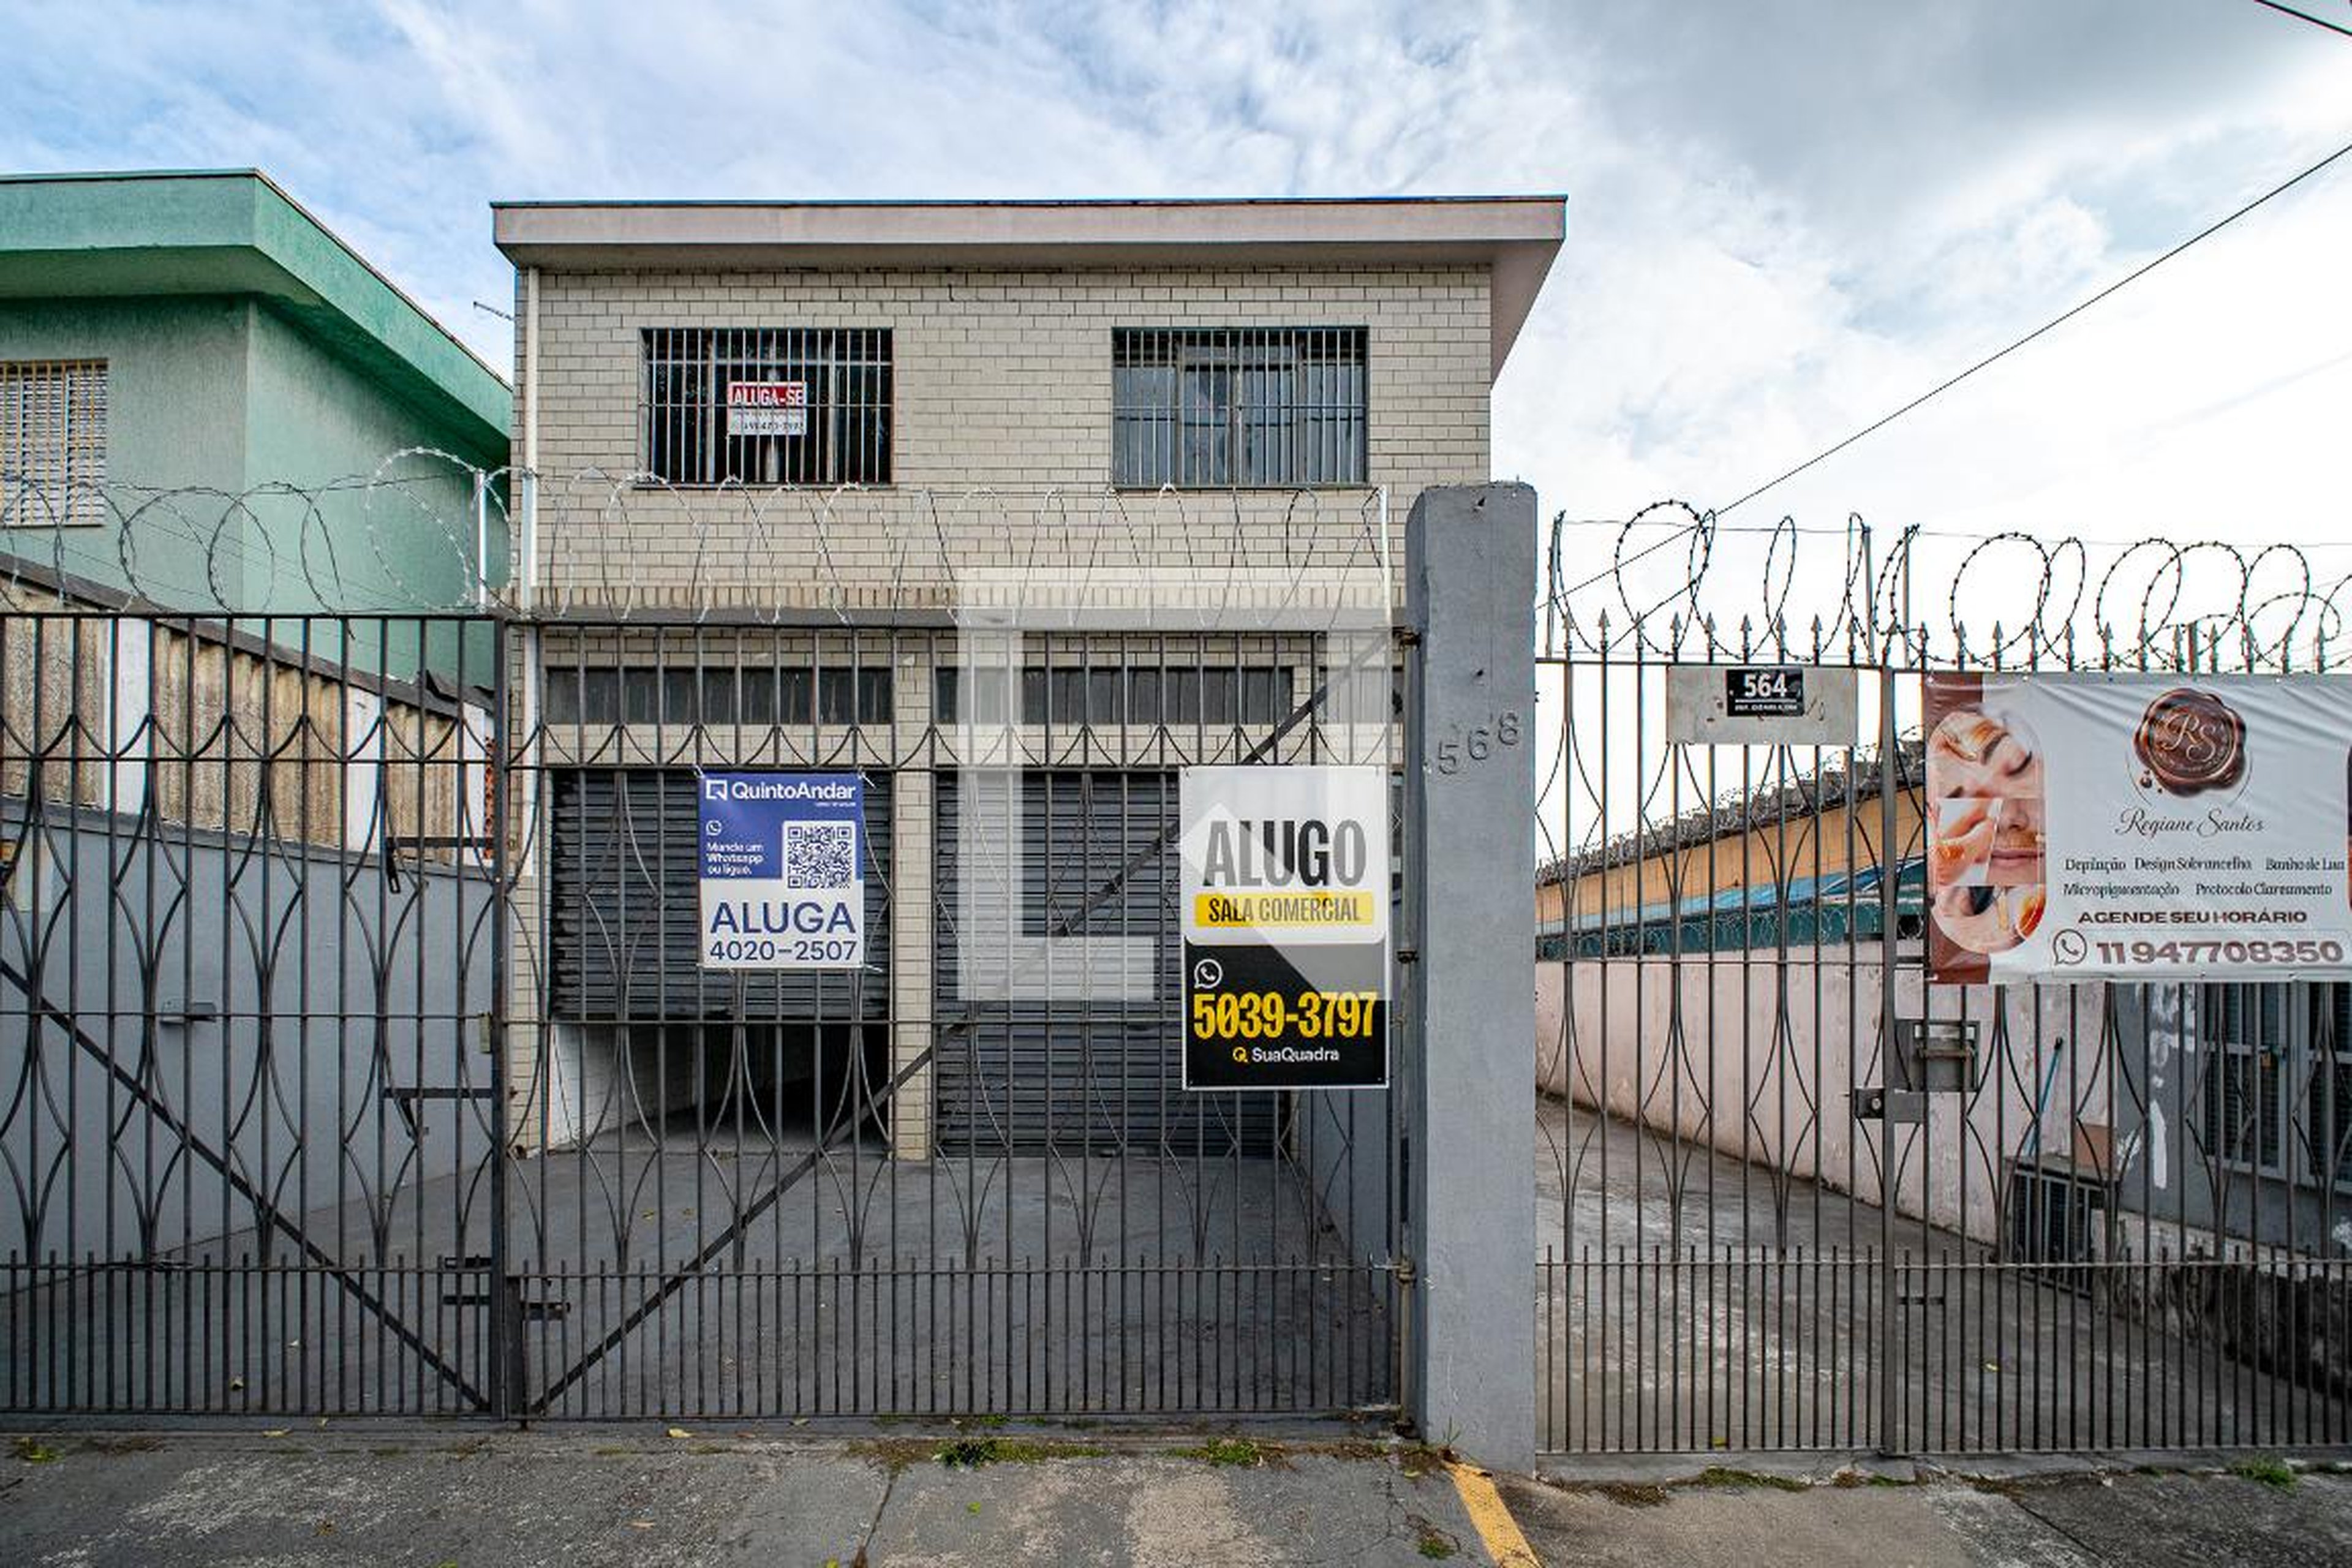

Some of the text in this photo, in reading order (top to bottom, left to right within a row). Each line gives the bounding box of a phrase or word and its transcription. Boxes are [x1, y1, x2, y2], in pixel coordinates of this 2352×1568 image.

[734, 387, 804, 406] ALUGA-SE
[1744, 673, 1788, 697] 564
[1438, 712, 1518, 775] 568
[731, 781, 856, 800] QuintoAndar
[2115, 807, 2266, 839] Regiane Santos
[1202, 820, 1367, 887] ALUGO
[2065, 857, 2127, 875] Depilação
[2135, 857, 2176, 874] Design
[2176, 857, 2253, 871] Sobrancelha
[2196, 883, 2252, 895] Protocolo
[2254, 881, 2332, 895] Clareamento
[710, 902, 856, 934] ALUGA
[1208, 897, 1360, 922] SALA COMERCIAL
[2078, 907, 2308, 924] AGENDE SEU HORÁRIO
[710, 940, 858, 960] 4020-2507
[1194, 990, 1378, 1039] 5039-3797
[1252, 1046, 1340, 1063] SuaQuadra
